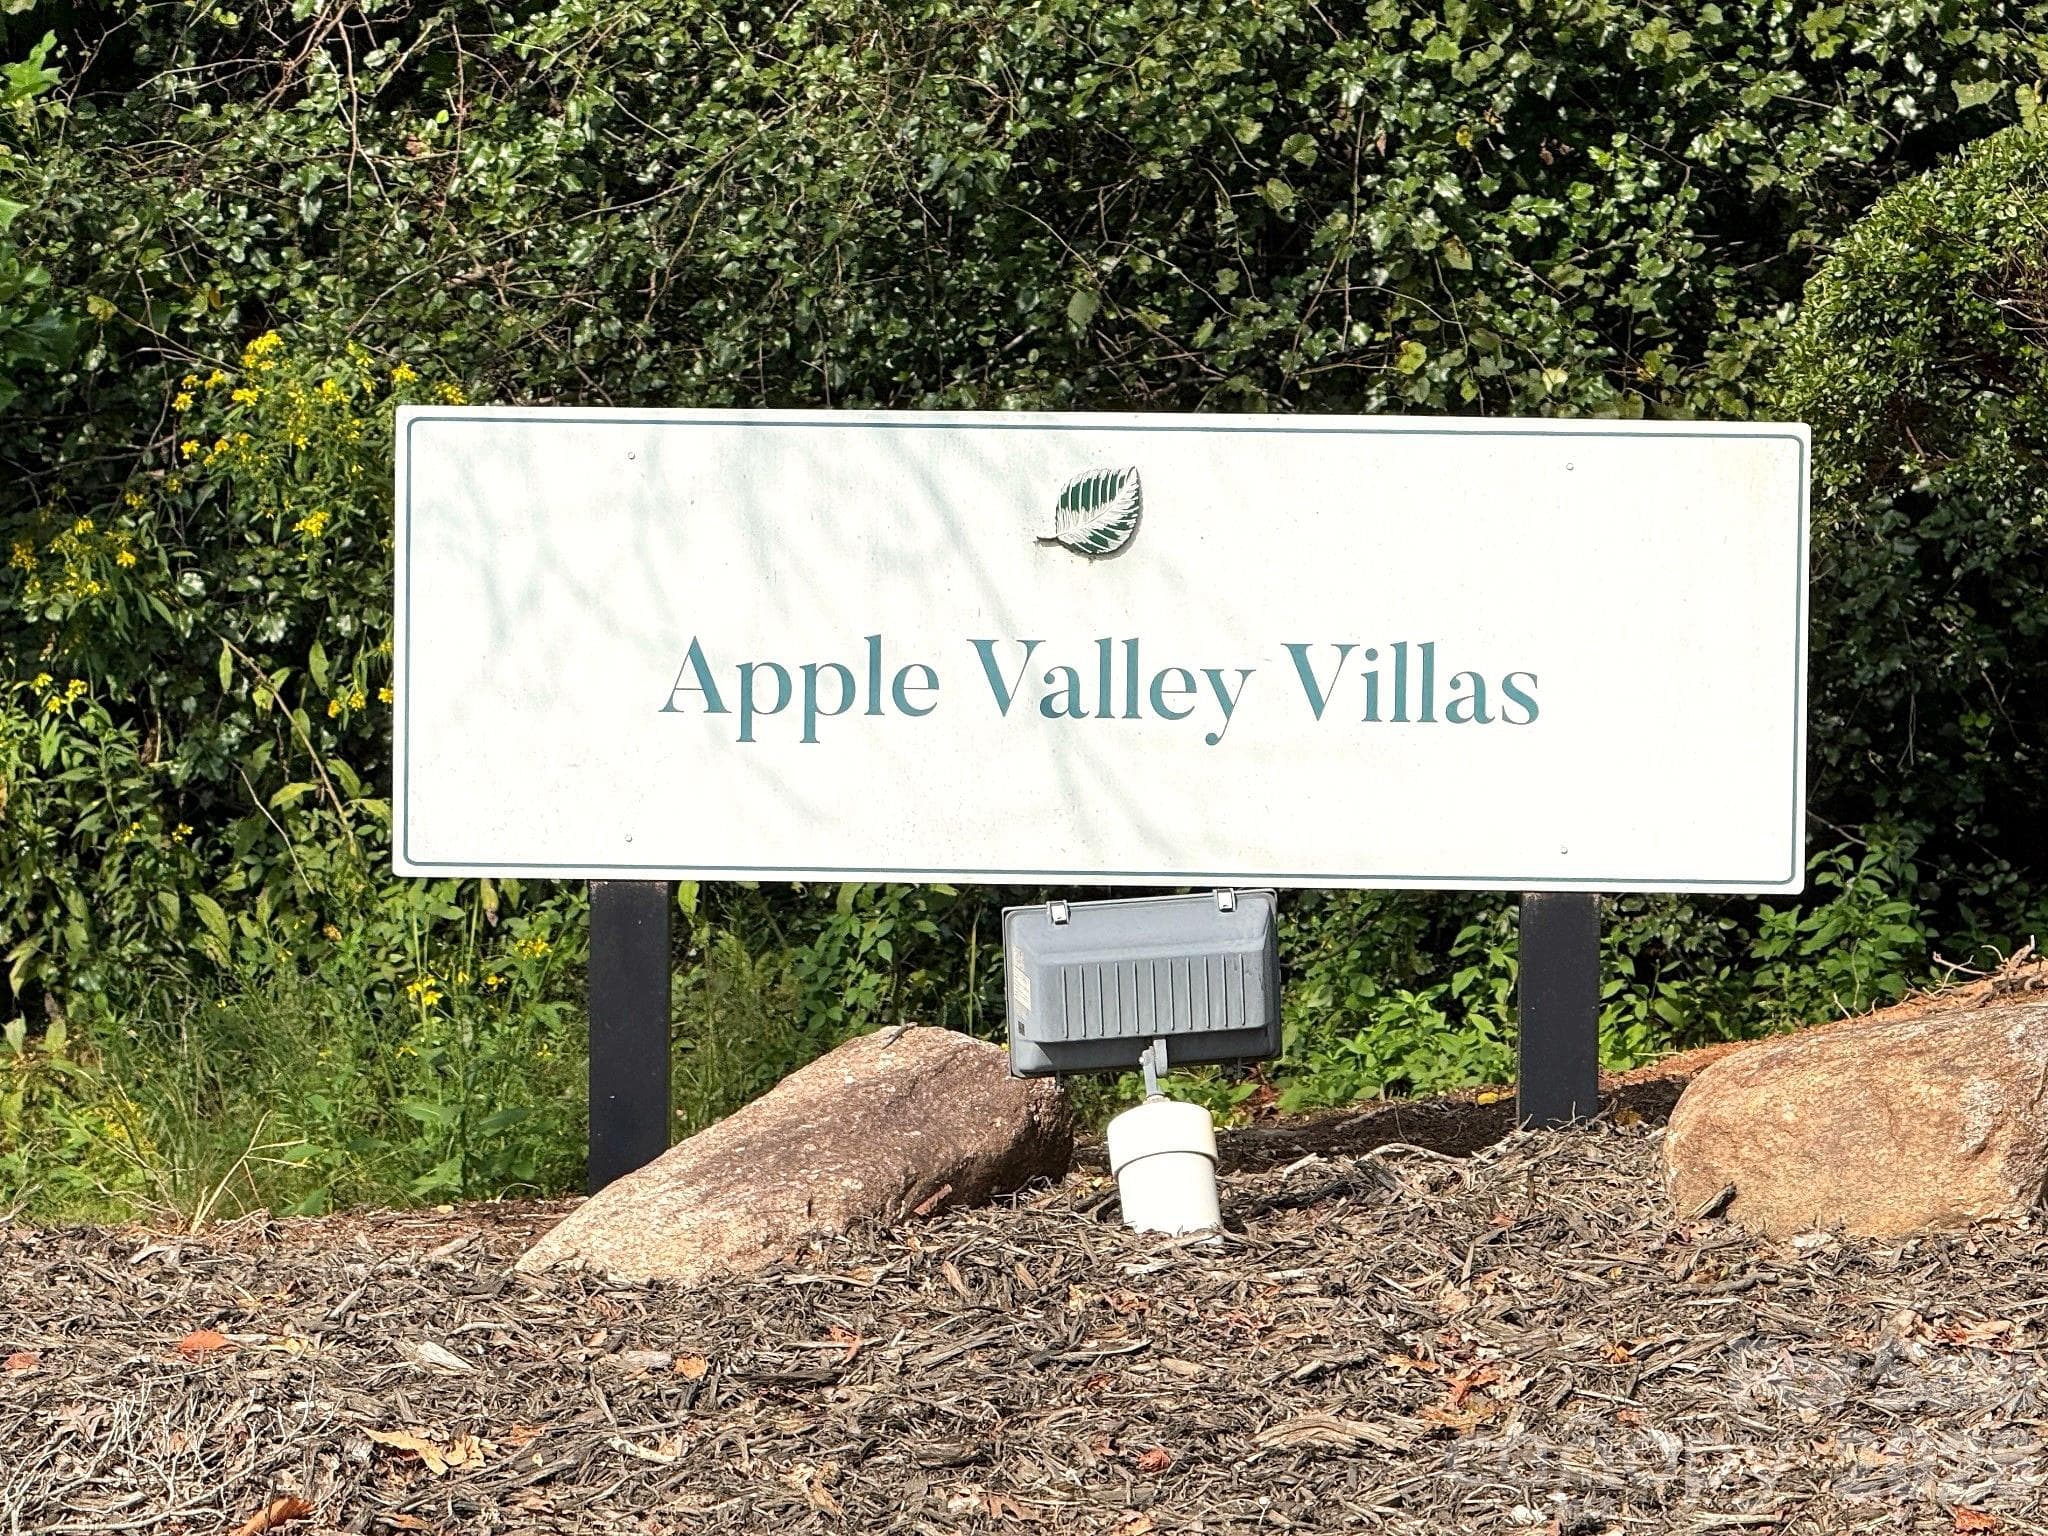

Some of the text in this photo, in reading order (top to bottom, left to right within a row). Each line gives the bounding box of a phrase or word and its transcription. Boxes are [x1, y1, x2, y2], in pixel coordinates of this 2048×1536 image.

[659, 634, 1541, 747] Apple Valley Villas
